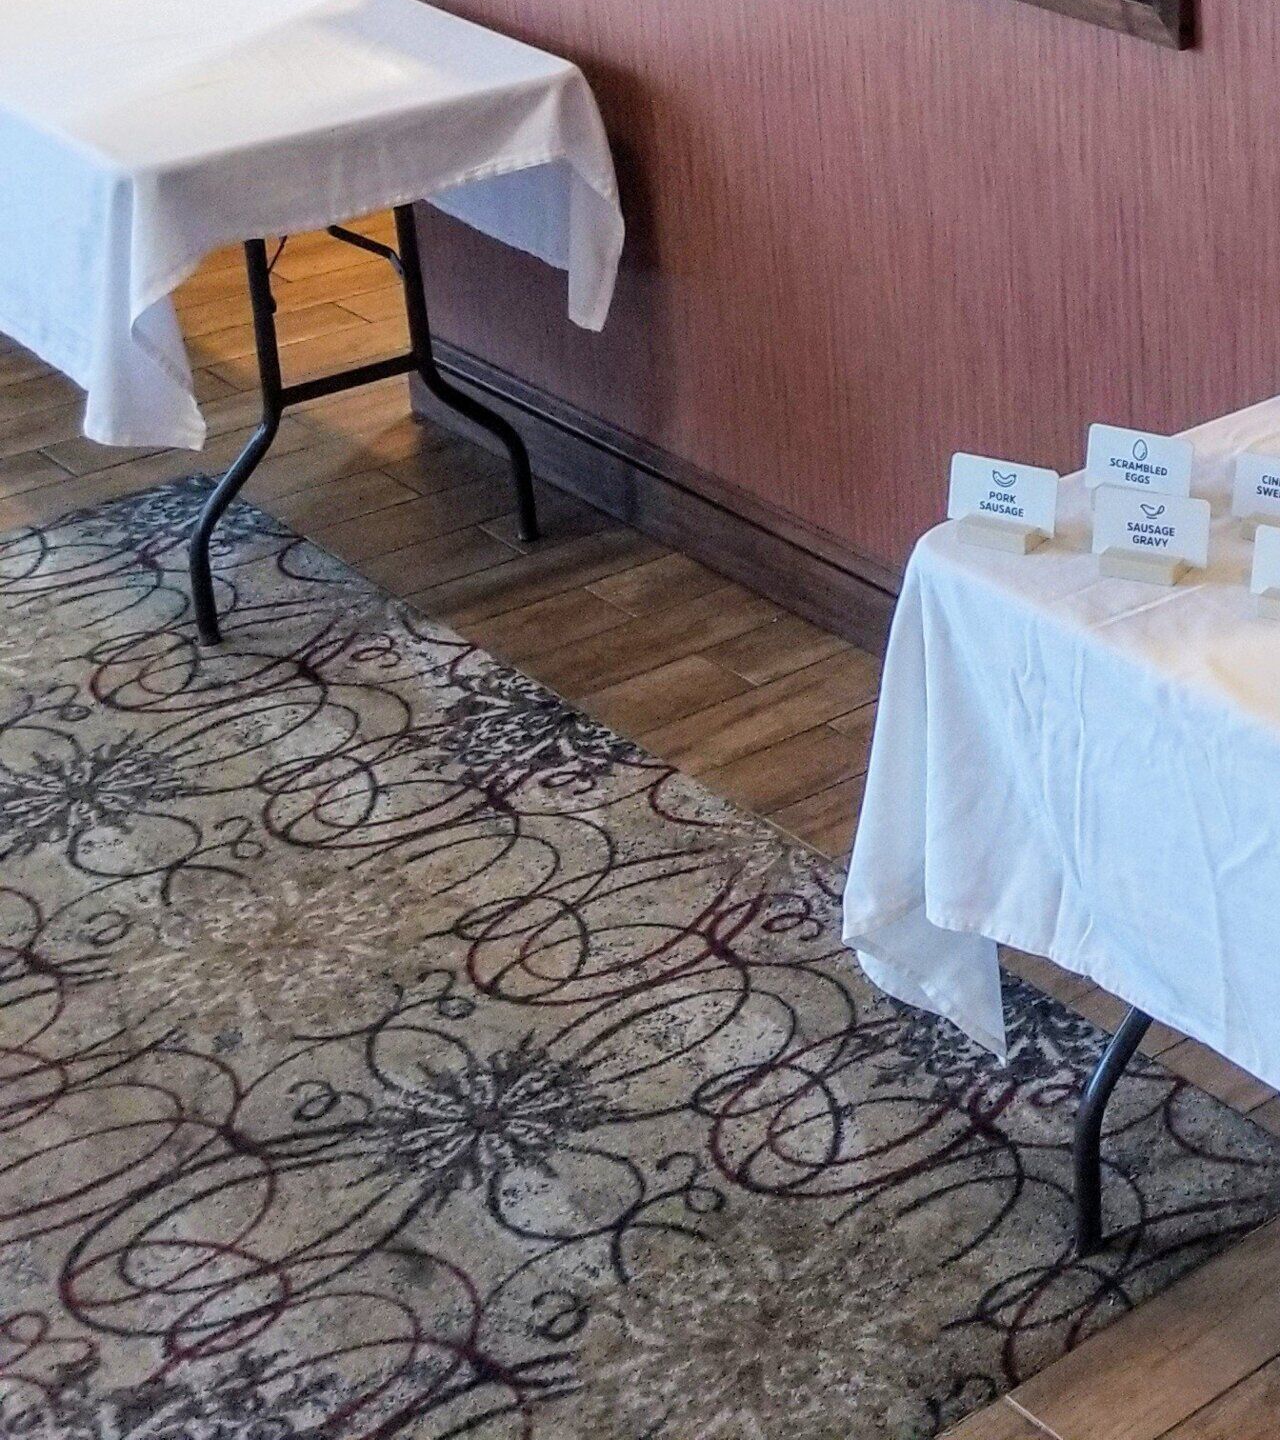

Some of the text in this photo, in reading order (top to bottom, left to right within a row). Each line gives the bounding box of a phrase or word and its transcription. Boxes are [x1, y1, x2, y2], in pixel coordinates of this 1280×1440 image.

[1109, 458, 1168, 476] SCRAMBLED
[1125, 472, 1151, 485] EGGS
[989, 491, 1017, 504] PORK
[979, 501, 1024, 517] SAUSAGE
[1127, 521, 1176, 537] SAUSAGE
[1132, 535, 1169, 548] GRAVY
